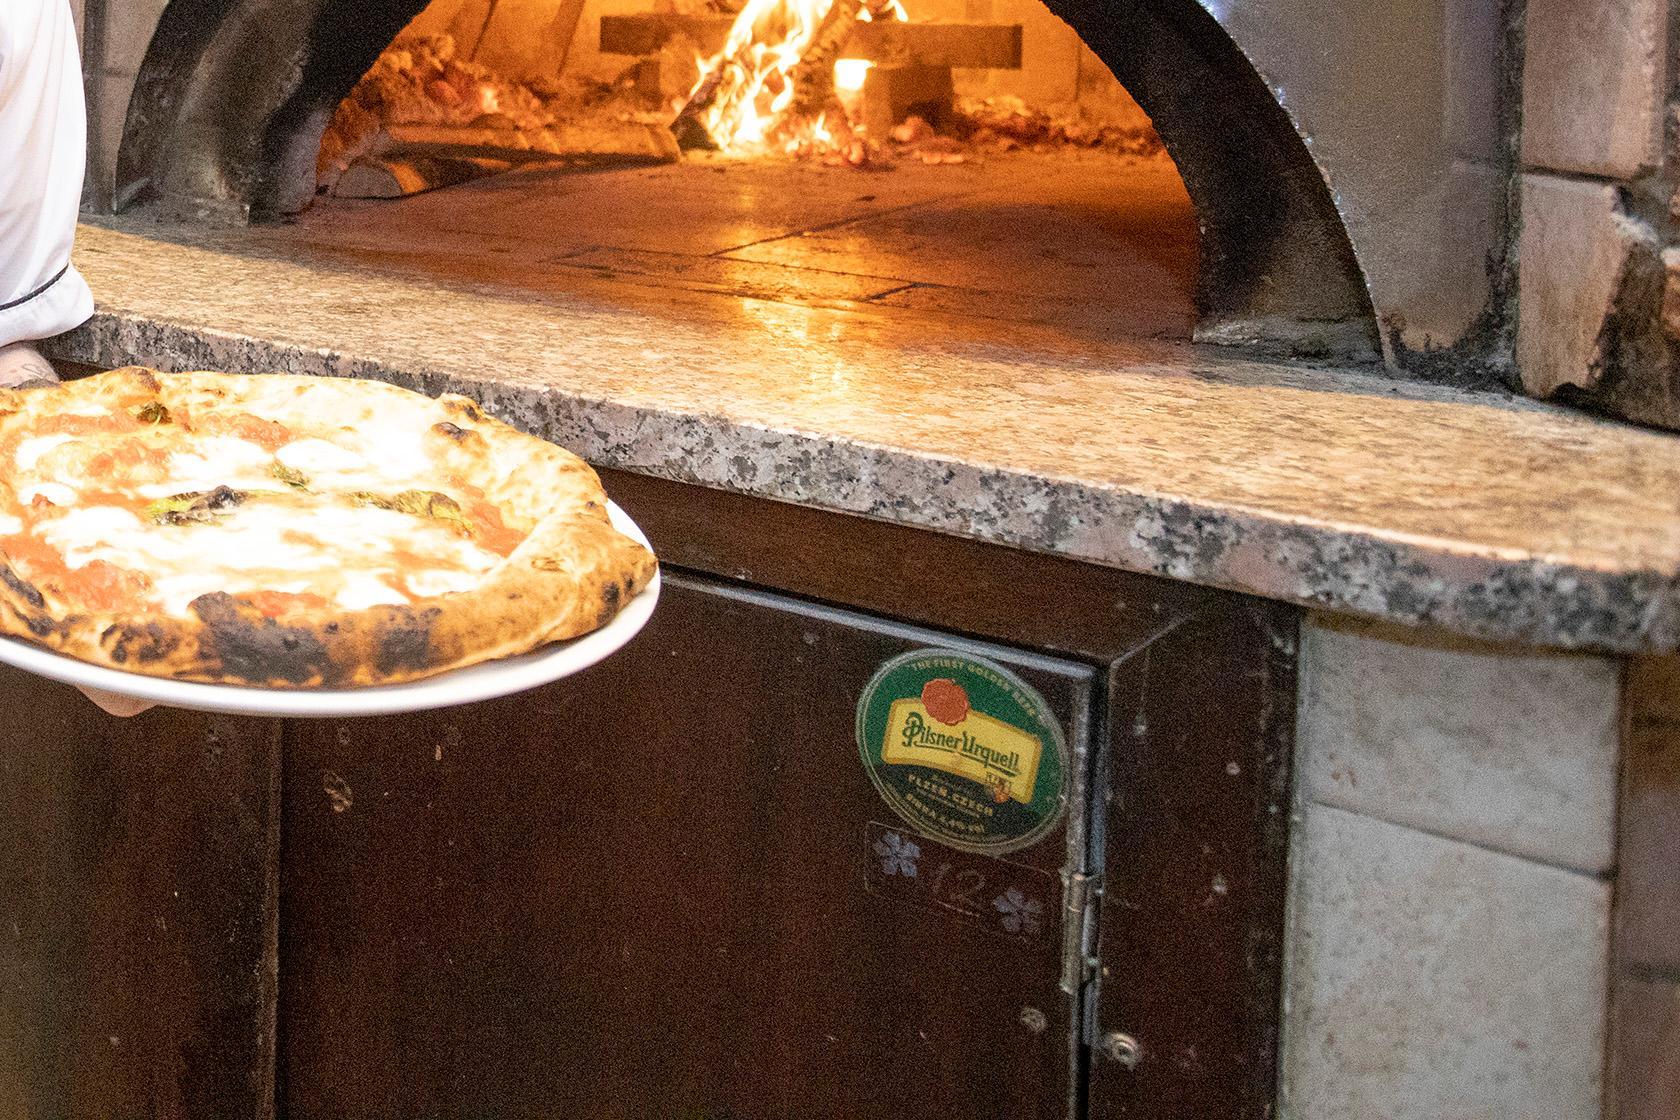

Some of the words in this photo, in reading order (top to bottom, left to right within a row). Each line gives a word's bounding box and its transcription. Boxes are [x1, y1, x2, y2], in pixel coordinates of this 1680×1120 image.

[933, 657, 965, 670] FIRST
[967, 663, 1012, 692] GOLDEN
[902, 711, 961, 749] Pilsner
[961, 730, 1020, 770] Urquell
